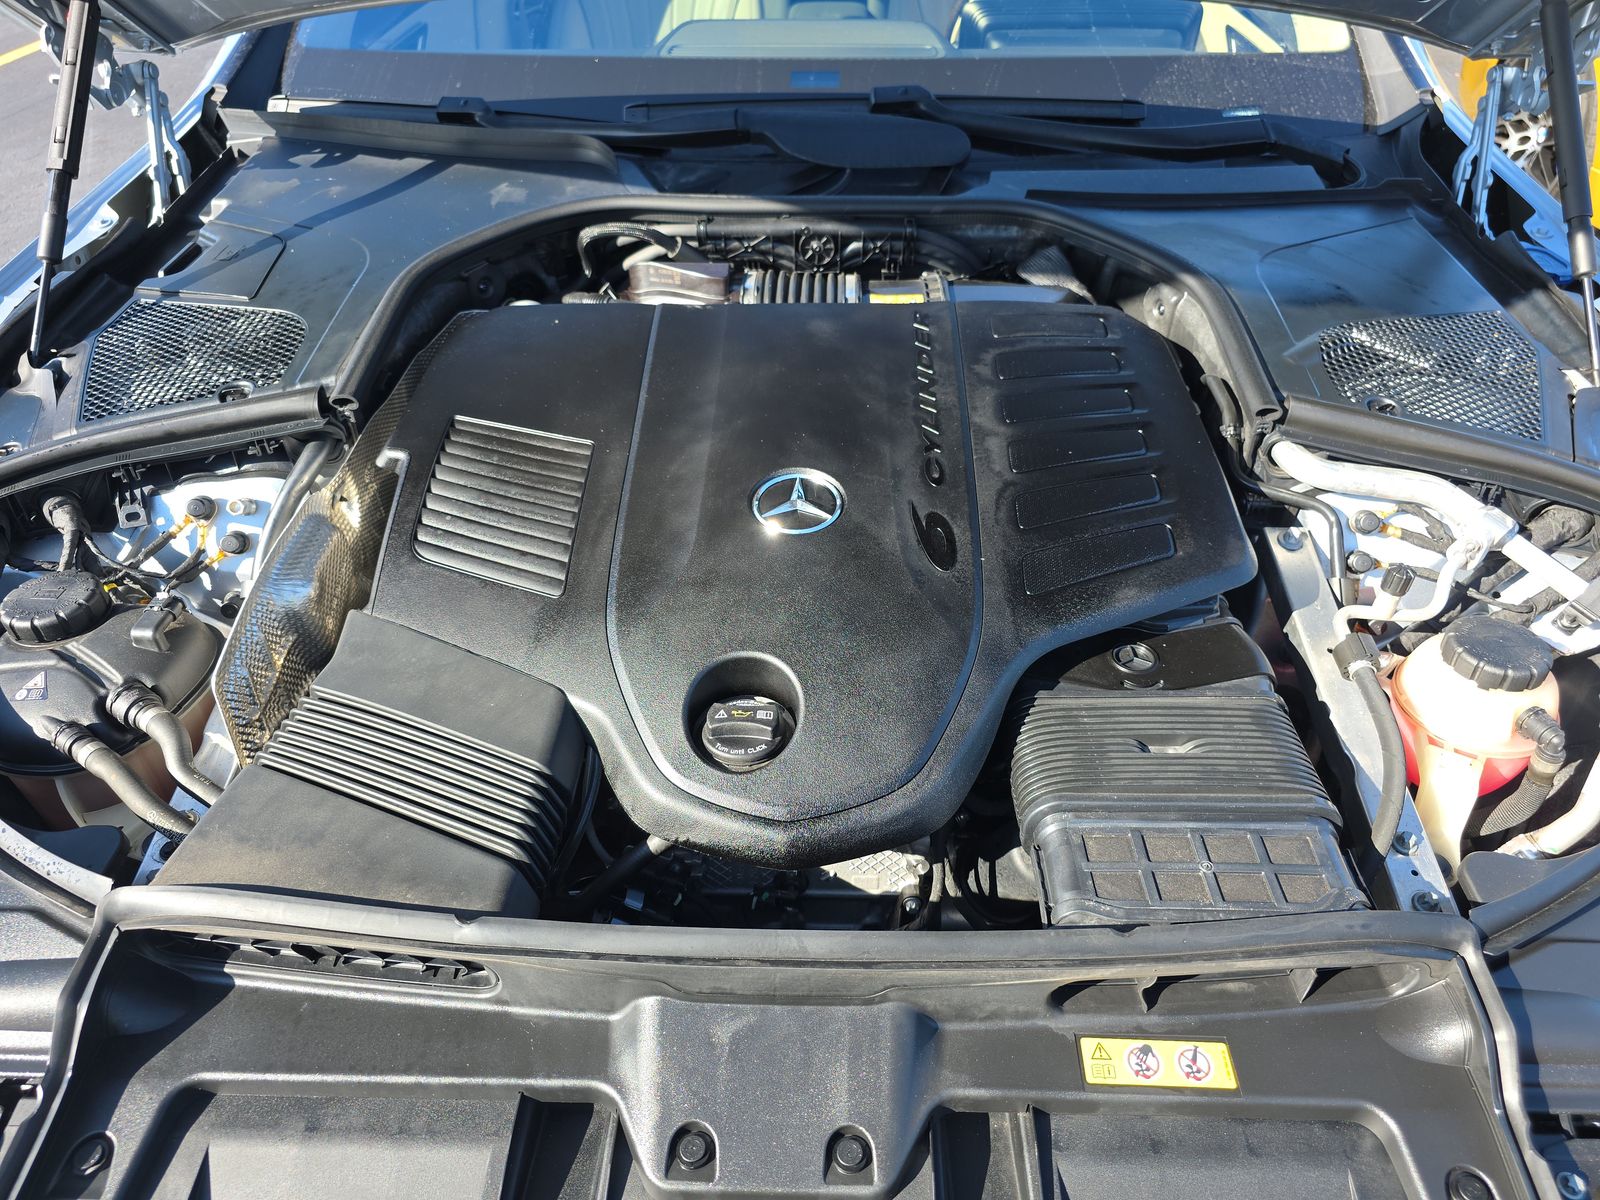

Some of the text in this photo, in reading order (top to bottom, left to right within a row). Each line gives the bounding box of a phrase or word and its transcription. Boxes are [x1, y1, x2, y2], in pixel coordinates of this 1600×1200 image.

[910, 310, 957, 573] 6 CYLINDER
[715, 743, 728, 753] Turn
[747, 743, 767, 754] CLICK
